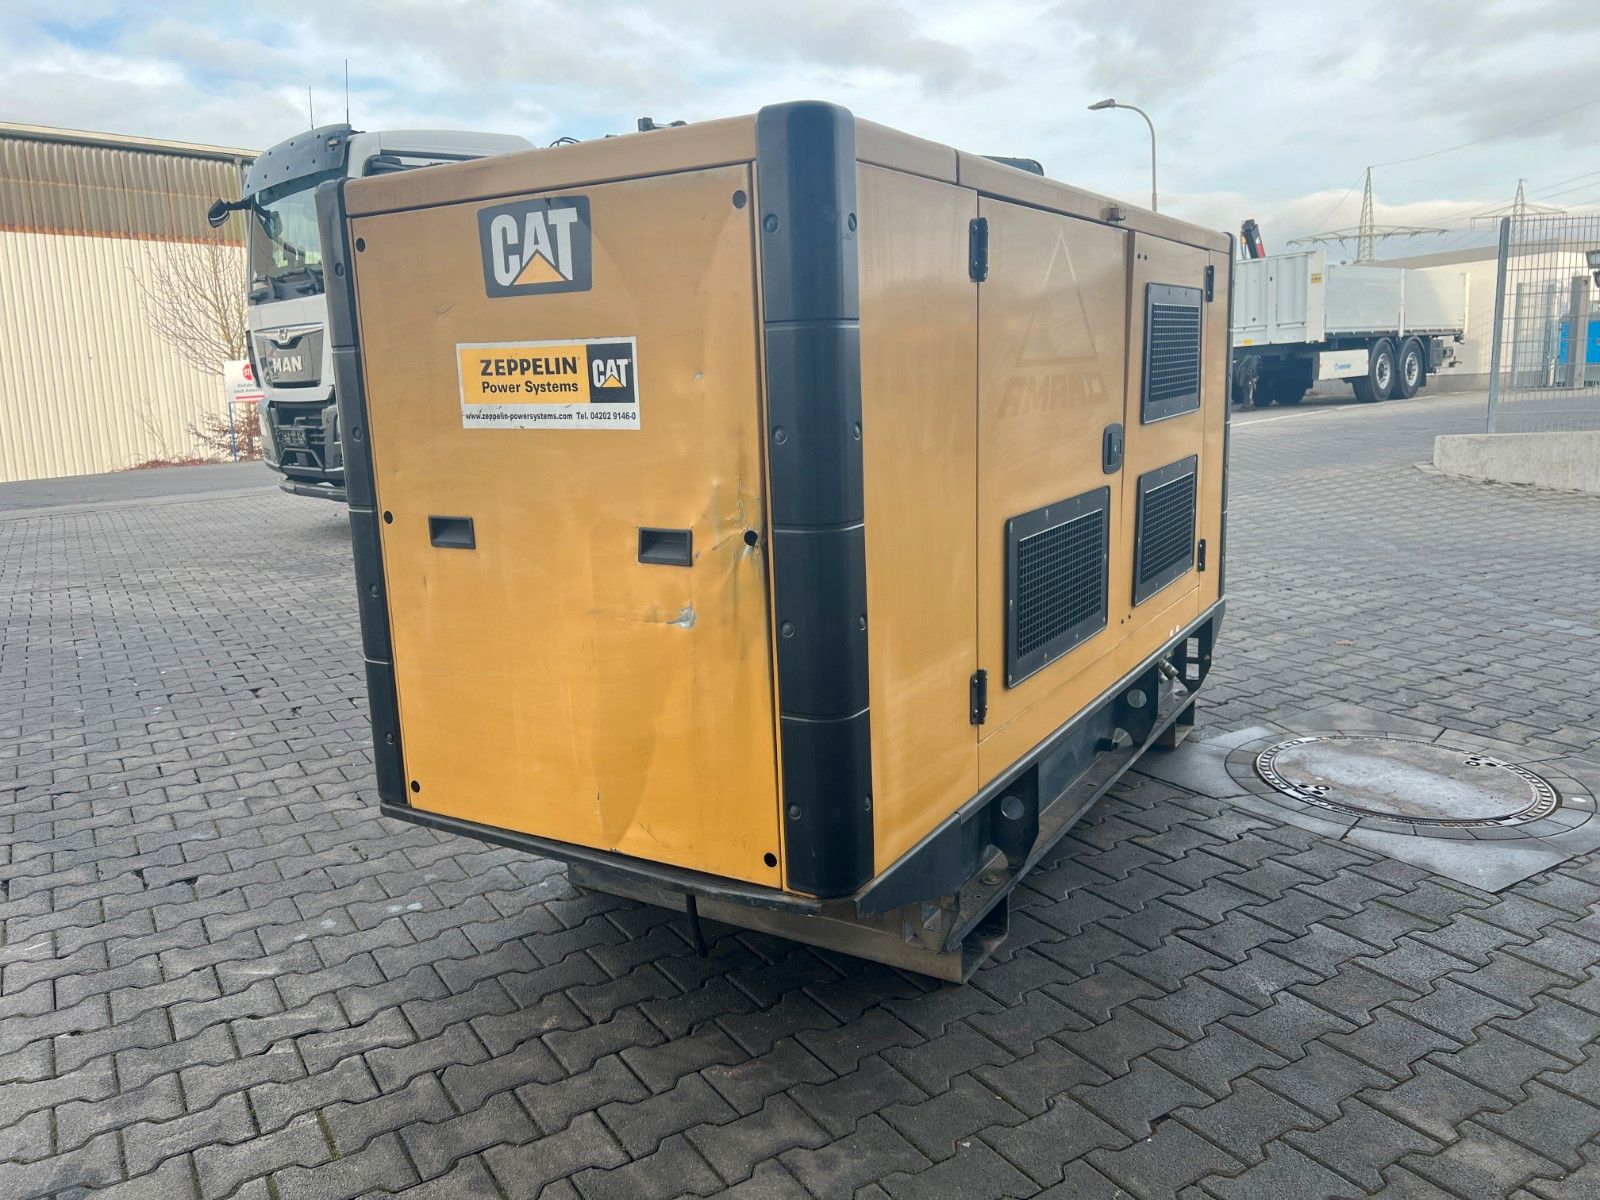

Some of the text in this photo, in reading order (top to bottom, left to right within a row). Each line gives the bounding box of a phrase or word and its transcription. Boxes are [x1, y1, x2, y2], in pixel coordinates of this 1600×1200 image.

[491, 207, 578, 286] CAT
[273, 356, 303, 373] MAN
[480, 356, 578, 376] ZEPPELIN
[592, 358, 629, 388] CAT
[482, 380, 578, 395] Power Systems
[465, 411, 636, 421] www.zeppelin-powersystems.com Tel. 04202 9146-0
